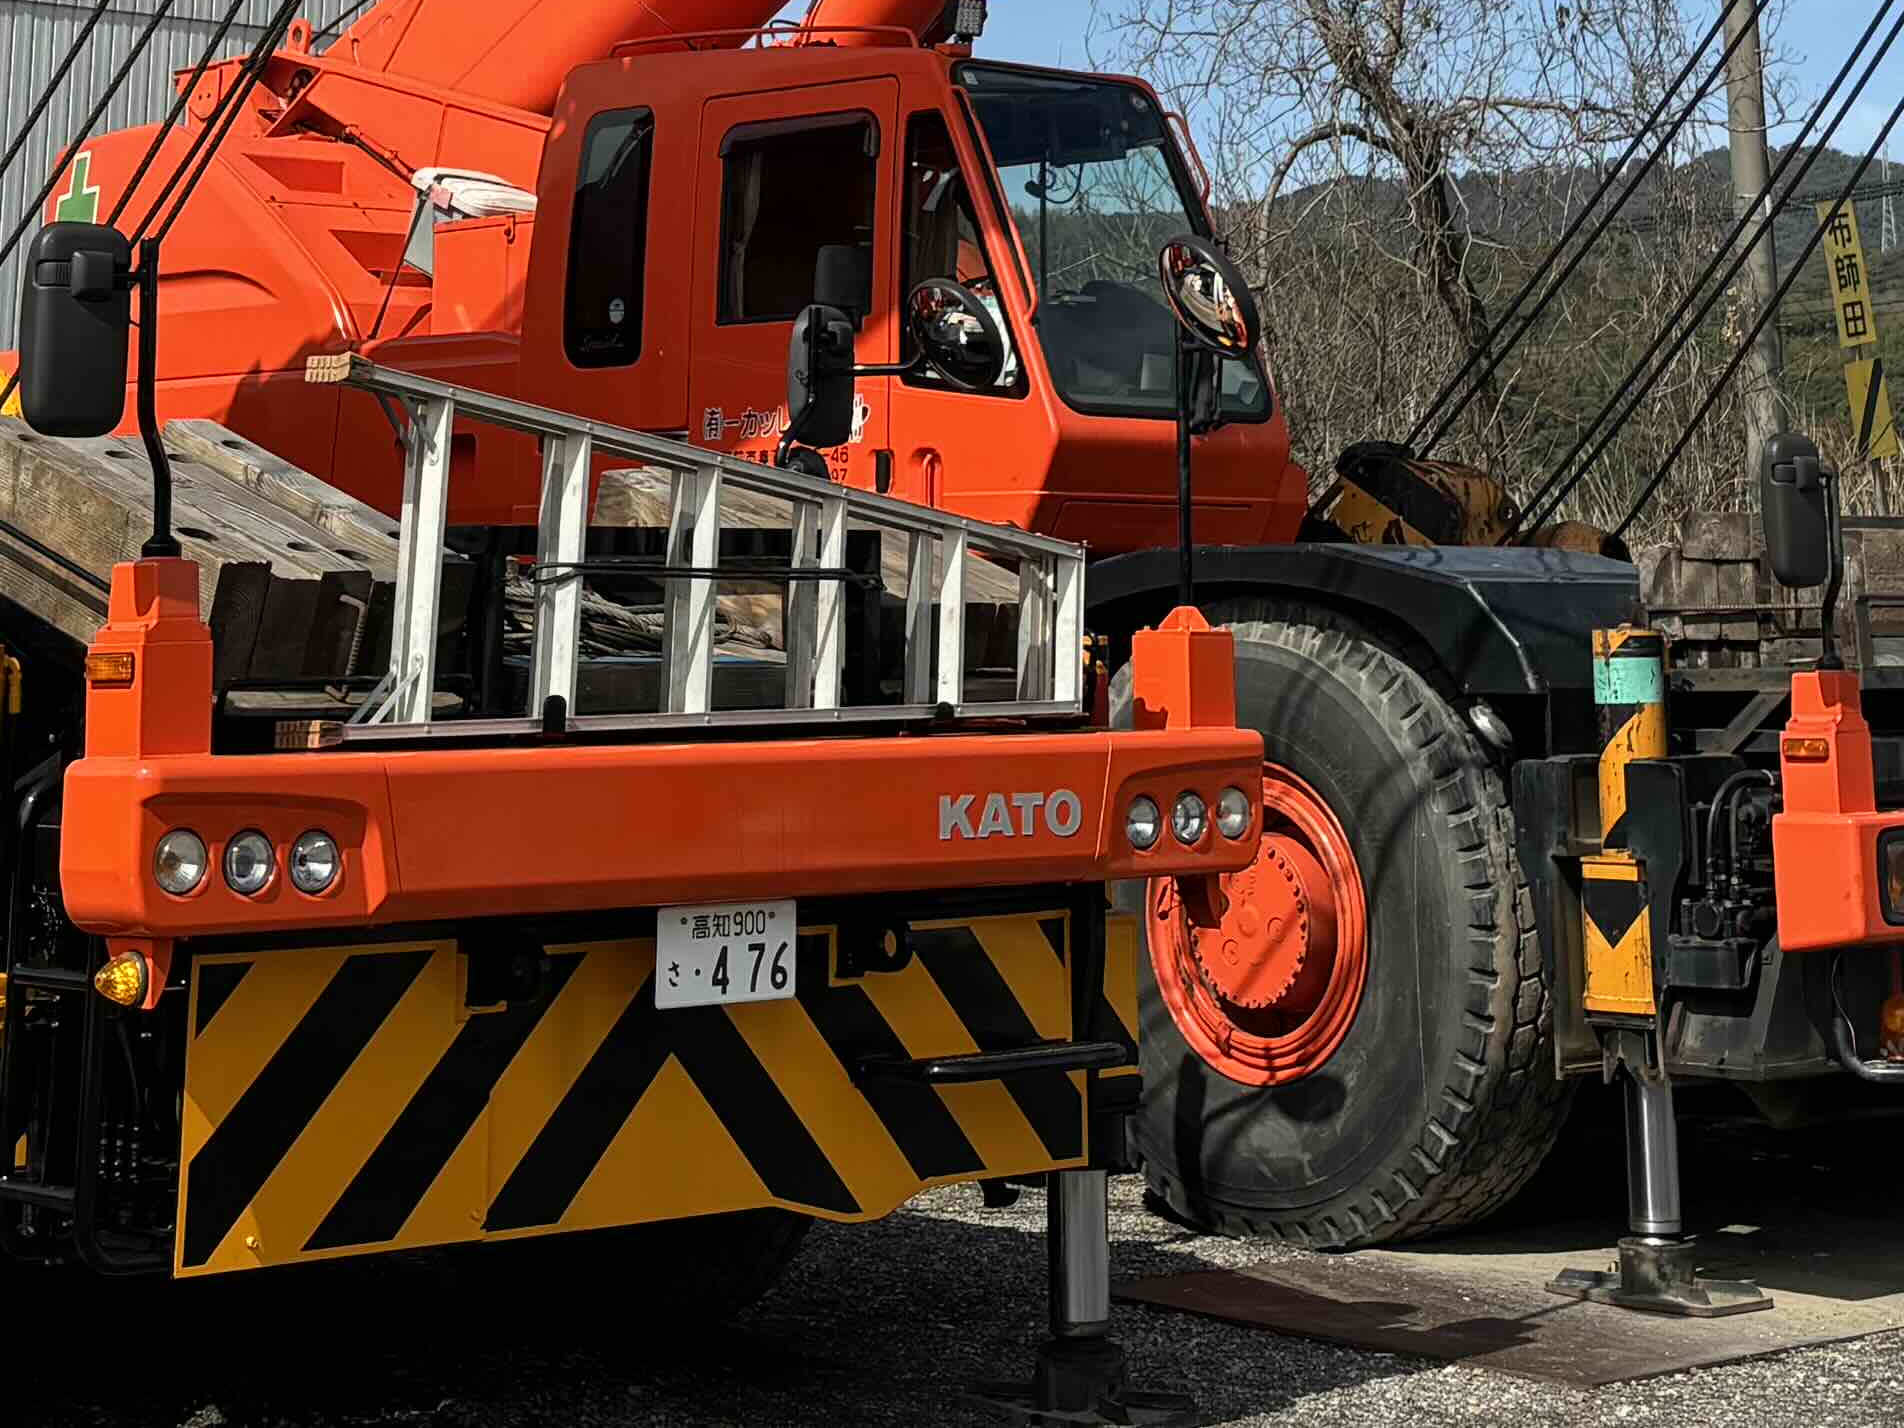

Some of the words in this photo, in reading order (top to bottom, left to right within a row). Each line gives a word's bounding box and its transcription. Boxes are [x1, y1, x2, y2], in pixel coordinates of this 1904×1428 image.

[1829, 212, 1867, 338] 布師田
[938, 789, 1082, 840] KATO
[668, 961, 679, 987] さ
